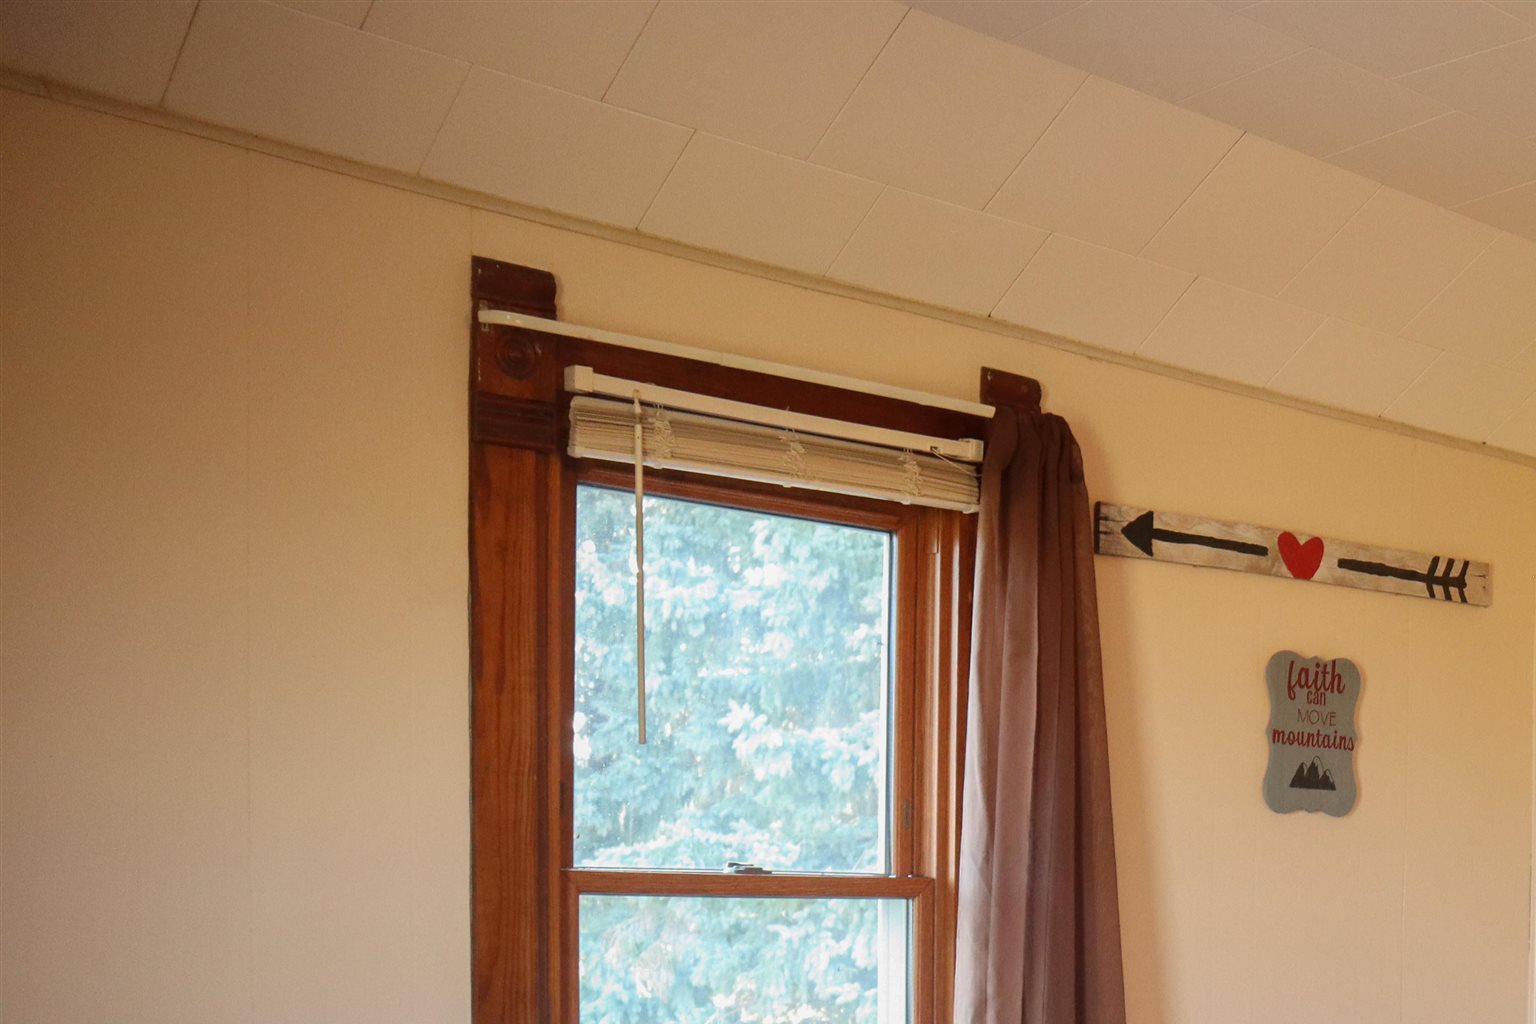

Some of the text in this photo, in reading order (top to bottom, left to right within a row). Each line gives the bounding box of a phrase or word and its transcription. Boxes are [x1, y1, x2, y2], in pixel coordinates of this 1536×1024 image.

[1287, 659, 1346, 701] faith
[1307, 690, 1326, 706] can
[1297, 708, 1337, 727] MOVE
[1272, 727, 1355, 752] mountains
